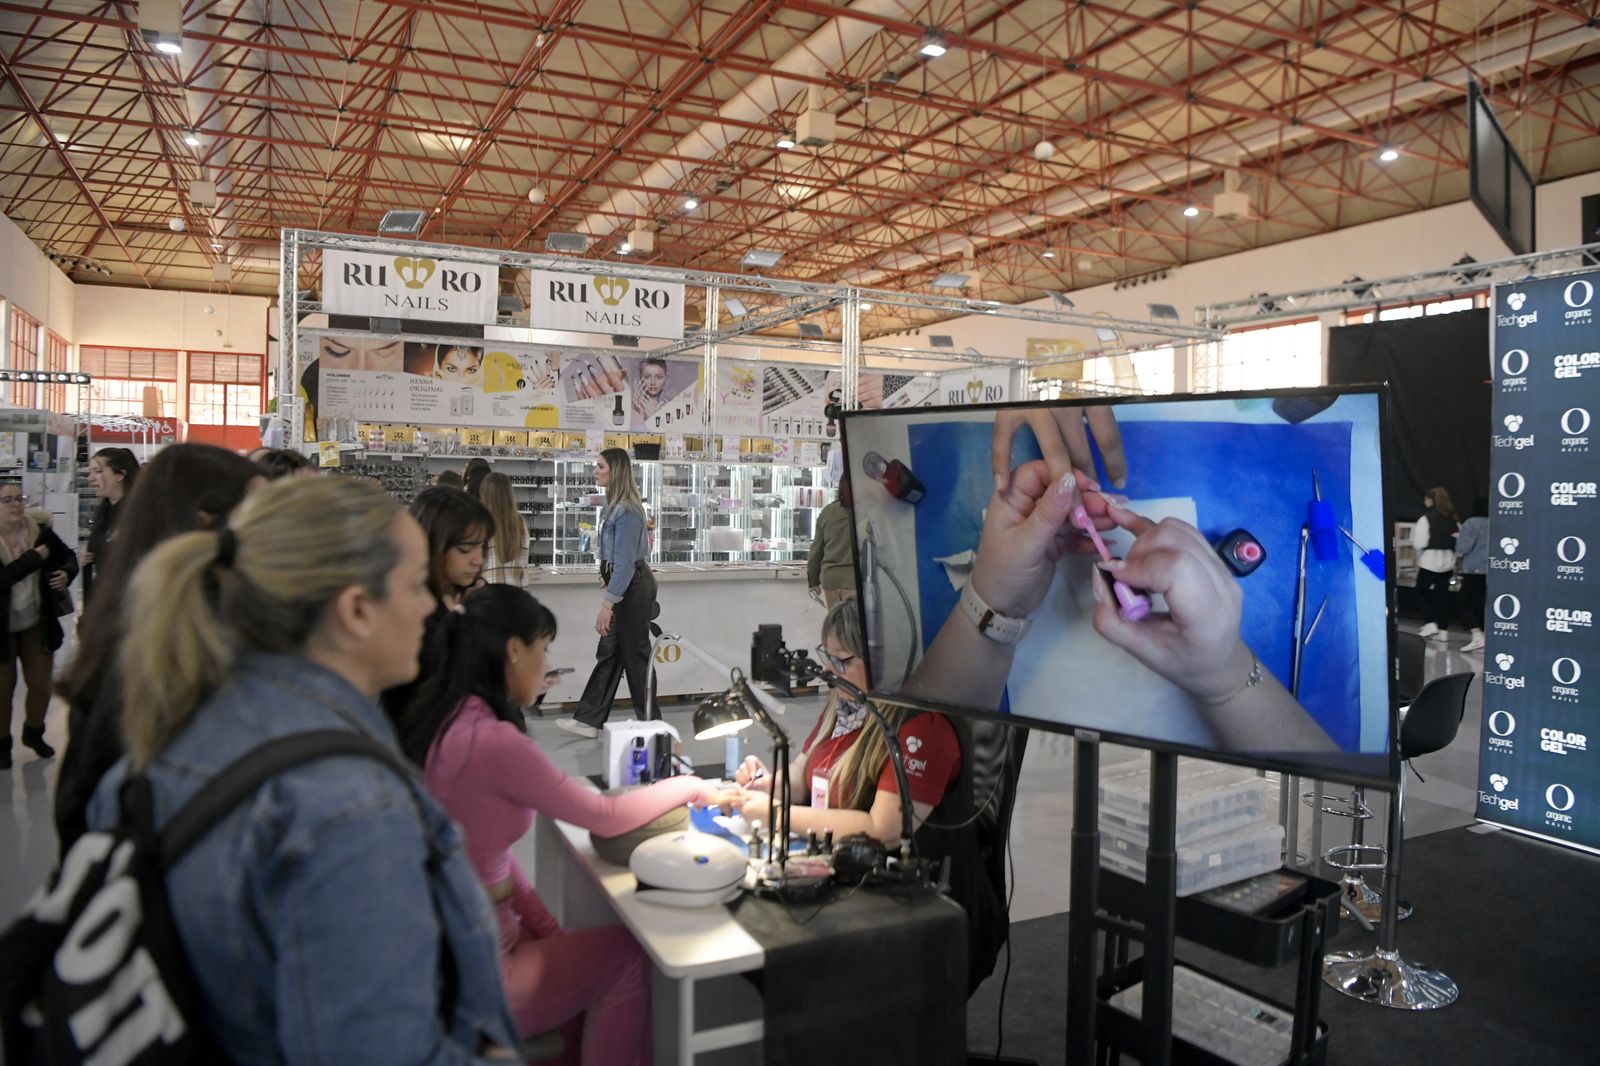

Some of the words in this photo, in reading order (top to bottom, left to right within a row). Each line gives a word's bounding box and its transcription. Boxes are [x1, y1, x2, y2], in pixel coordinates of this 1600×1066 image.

[344, 262, 387, 287] RU
[442, 269, 482, 293] RO
[549, 280, 589, 303] RU
[635, 287, 670, 310] RO
[384, 294, 449, 312] NAILS
[585, 311, 641, 327] NAILS
[1497, 311, 1537, 327] Techgel
[1565, 309, 1591, 319] organic
[1554, 352, 1600, 367] COLOR
[1555, 367, 1582, 378] GEL
[1503, 377, 1526, 387] organic
[409, 385, 444, 393] ORIGINAL
[985, 384, 1003, 403] RO
[1494, 434, 1534, 449] Techgel
[1562, 437, 1588, 446] organic
[1551, 482, 1596, 493] COLOR
[1499, 501, 1523, 509] organic
[1551, 494, 1578, 505] GEL
[1490, 557, 1529, 573] Techgel
[1557, 565, 1584, 574] organic
[1546, 608, 1592, 622] COLOR
[1494, 622, 1518, 630] organic
[1546, 620, 1574, 632] GEL
[1484, 670, 1524, 689] Techgel
[1552, 686, 1578, 696] organic
[1489, 738, 1513, 747] organic
[1541, 728, 1586, 745] COLOR
[1541, 740, 1567, 754] GEL
[1479, 790, 1518, 810] Techgel
[1546, 811, 1572, 823] organic
